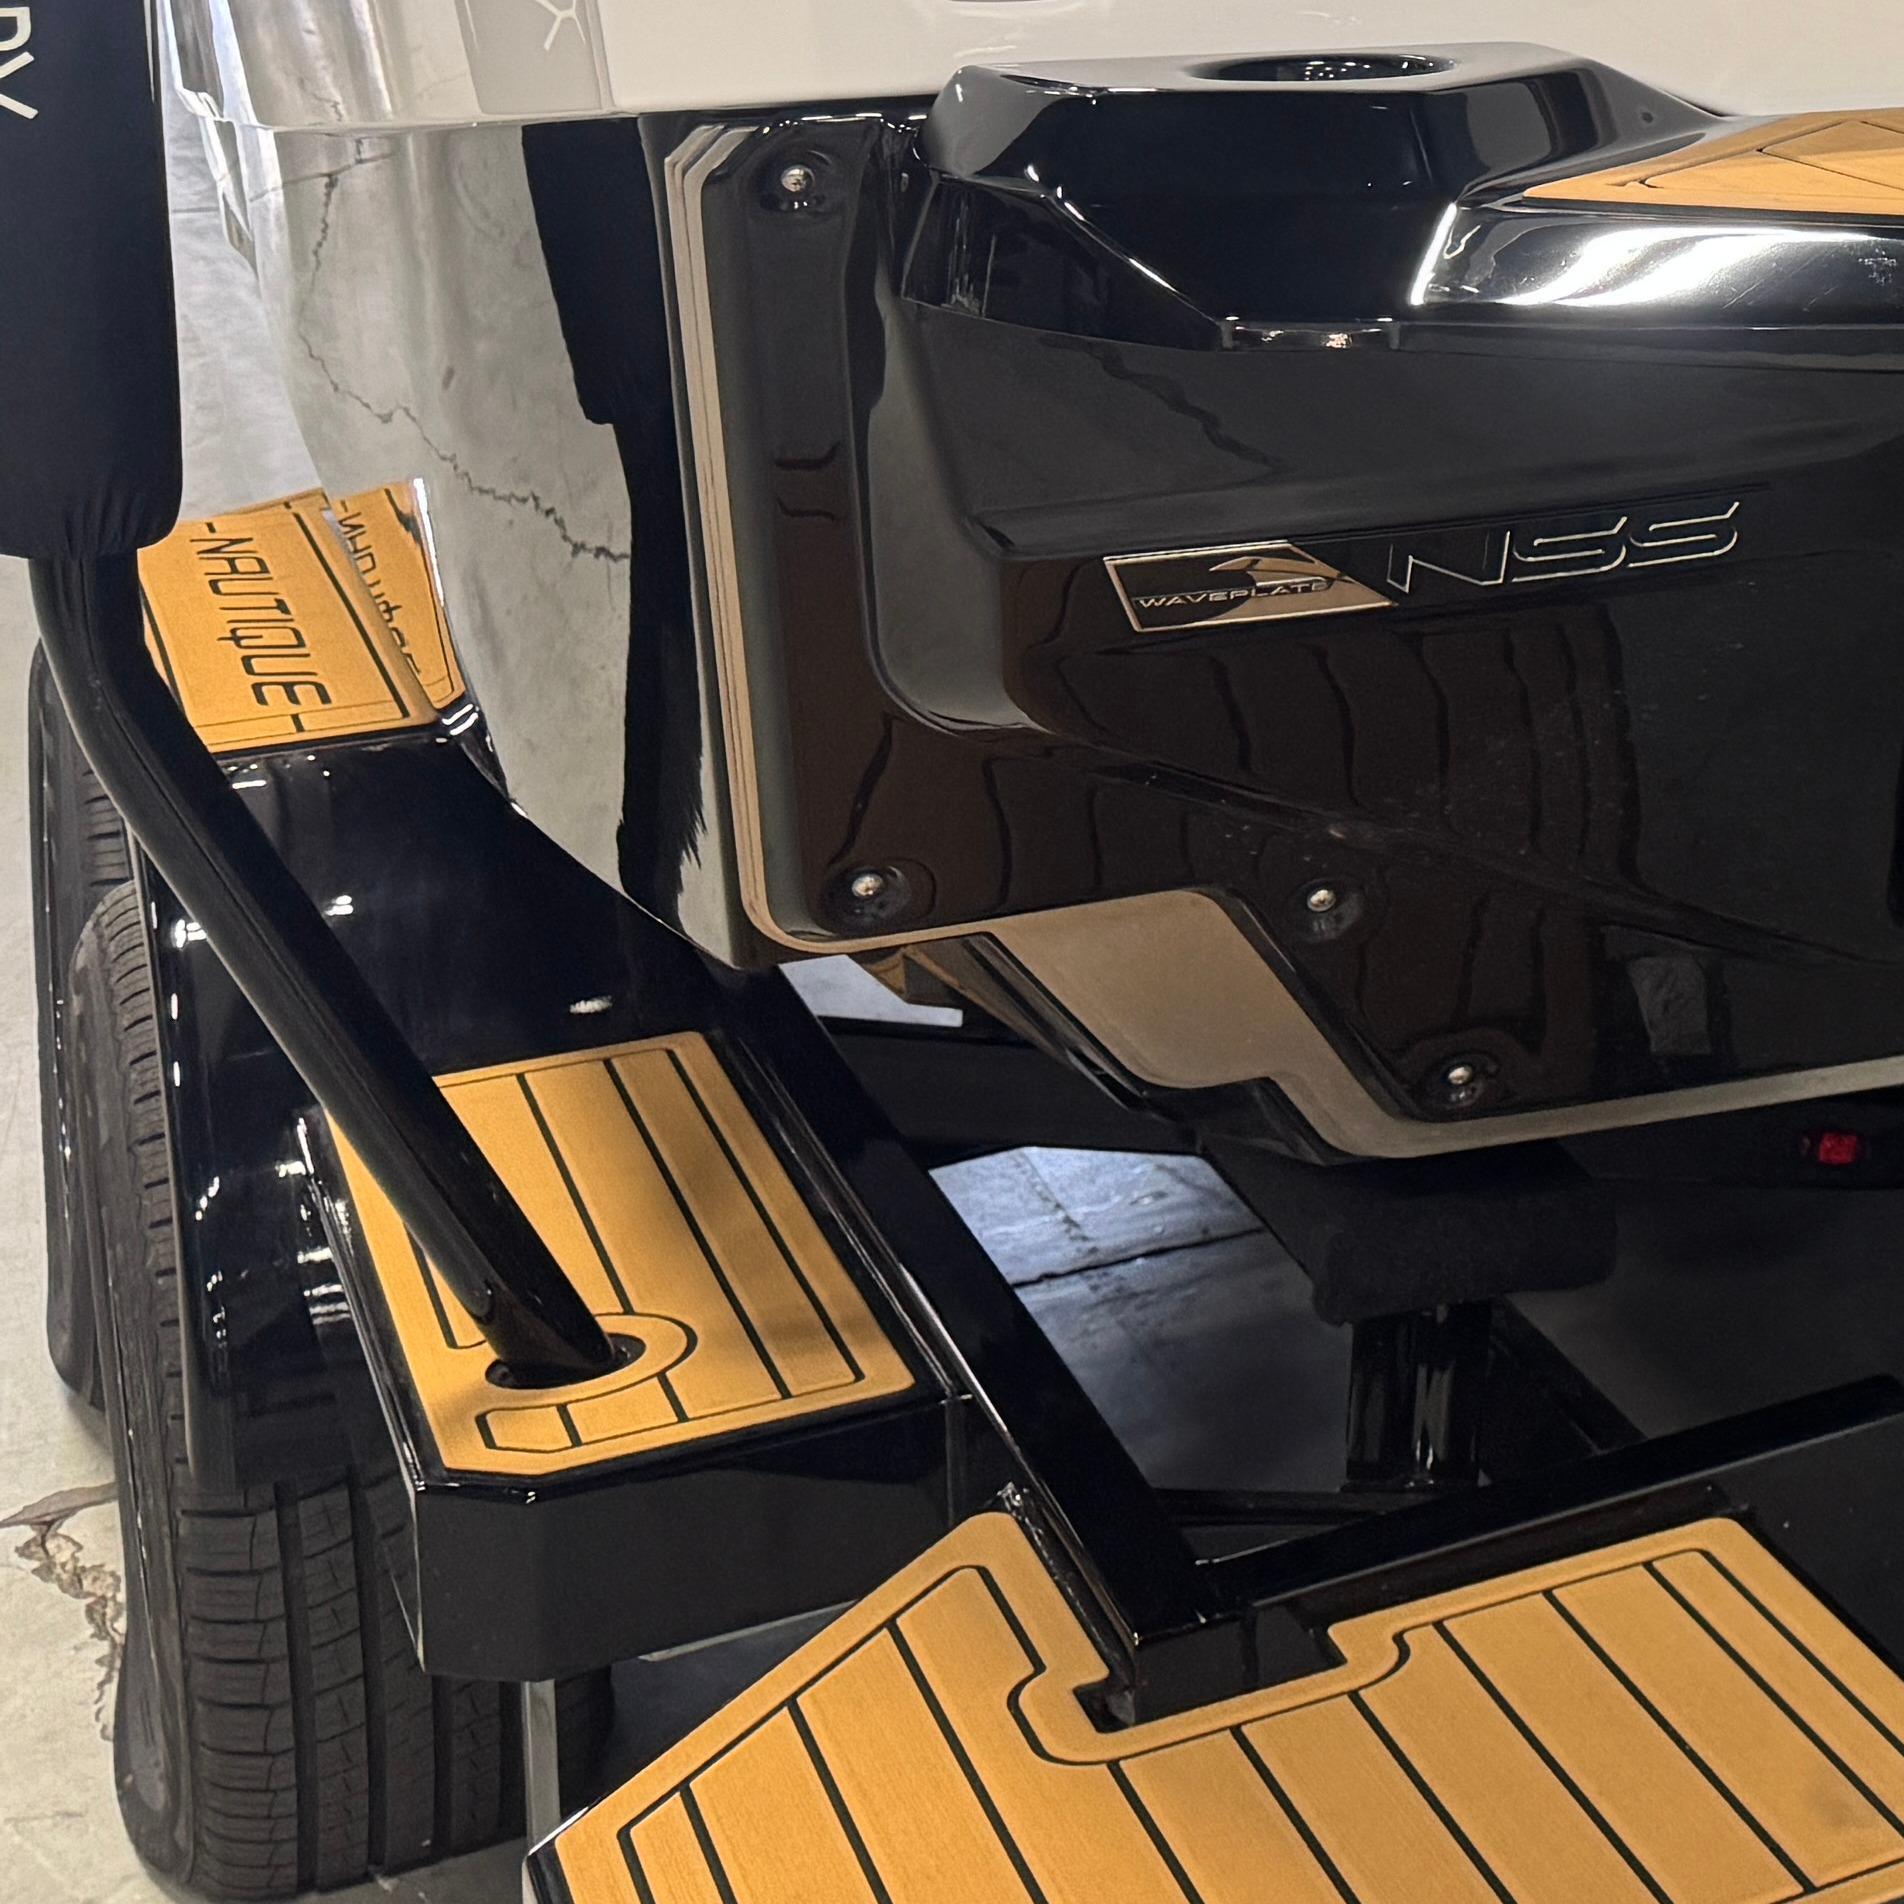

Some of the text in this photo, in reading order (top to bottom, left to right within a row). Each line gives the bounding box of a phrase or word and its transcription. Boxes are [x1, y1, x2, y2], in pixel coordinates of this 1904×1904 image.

[1138, 577, 1330, 608] WAVEPLATE
[1386, 500, 1742, 595] NSS
[189, 537, 332, 706] NAUTIQUE
